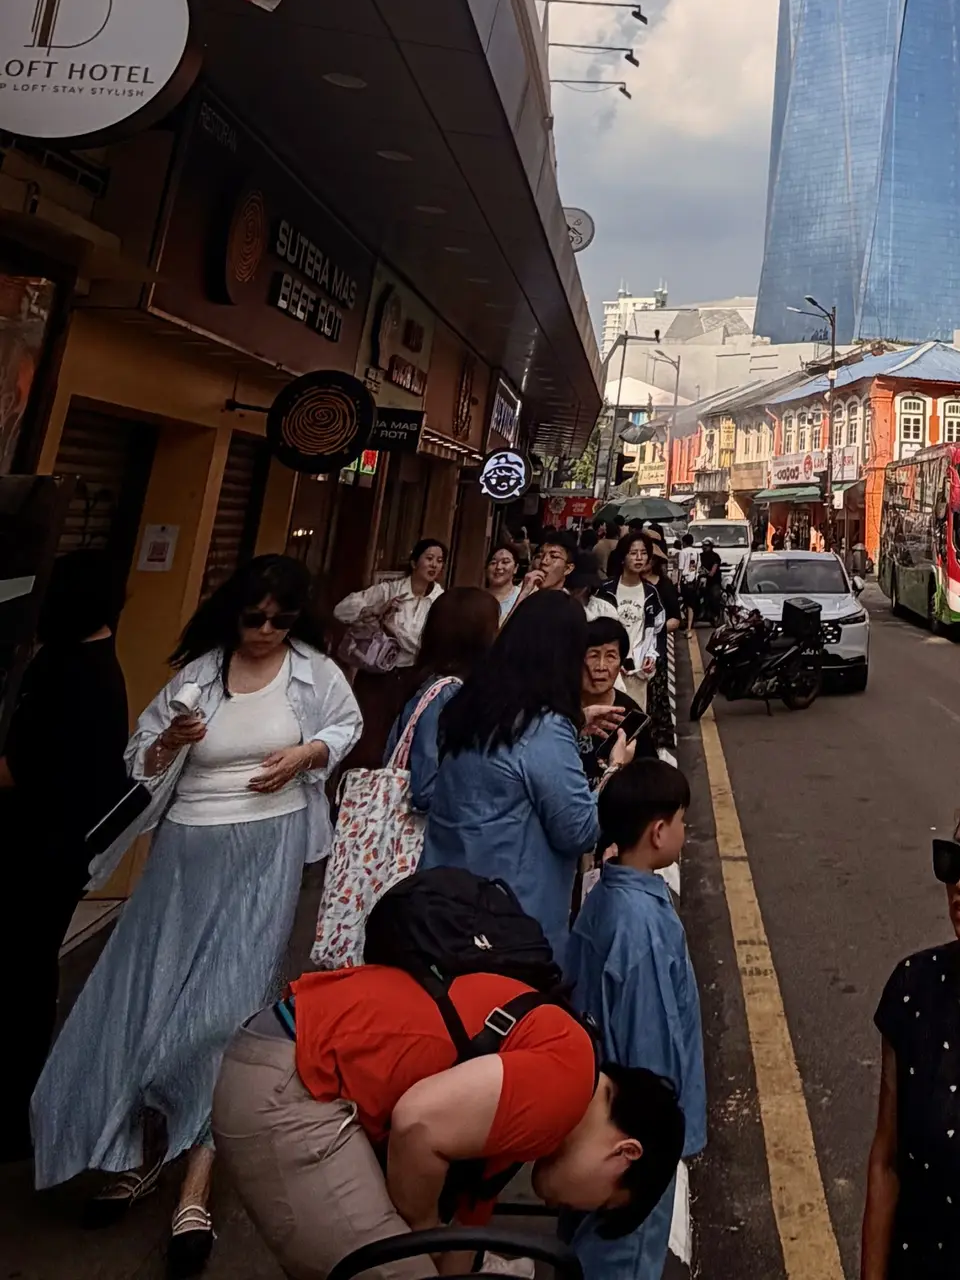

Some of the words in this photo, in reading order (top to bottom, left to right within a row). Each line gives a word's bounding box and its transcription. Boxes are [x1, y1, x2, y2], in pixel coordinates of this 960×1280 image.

[0, 59, 58, 78] OFT
[68, 63, 154, 84] HOTEL
[91, 87, 144, 97] STYLISH
[201, 101, 238, 154] RESTORAN
[276, 220, 332, 290] SUTERA
[331, 265, 358, 310] MAS
[277, 272, 317, 323] BEEF
[380, 430, 407, 440] ROTI
[390, 421, 418, 431] MAS
